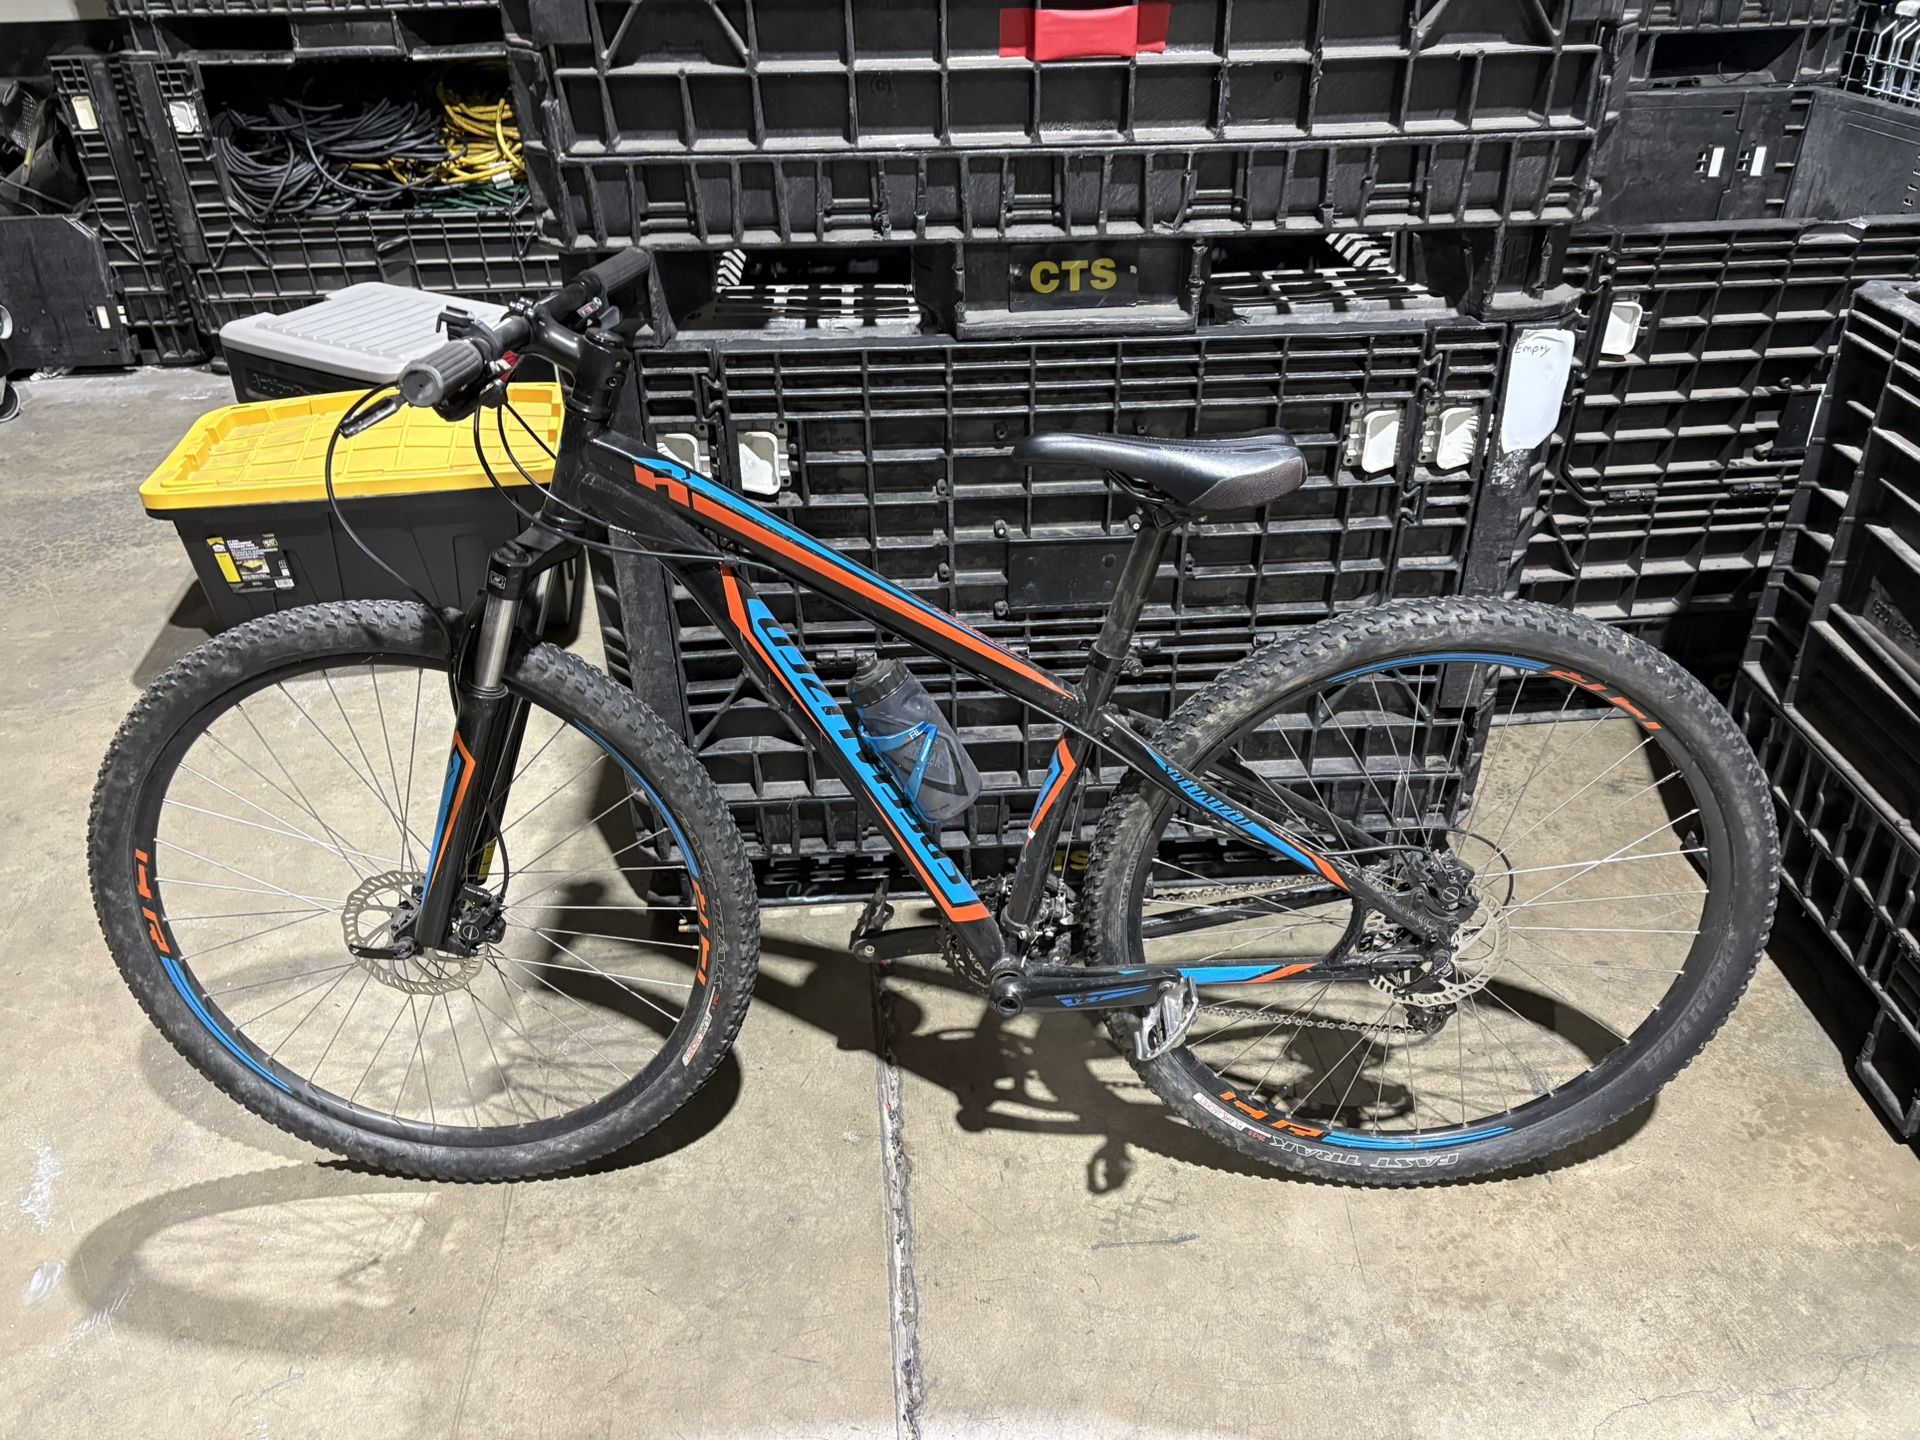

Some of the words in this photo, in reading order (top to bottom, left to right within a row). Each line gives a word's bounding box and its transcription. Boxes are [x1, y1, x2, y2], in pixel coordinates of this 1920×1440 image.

[1030, 257, 1117, 294] CTS
[1515, 341, 1551, 358] Empty
[1269, 1137, 1362, 1167] TRAK
[1369, 1152, 1459, 1167] FAST
